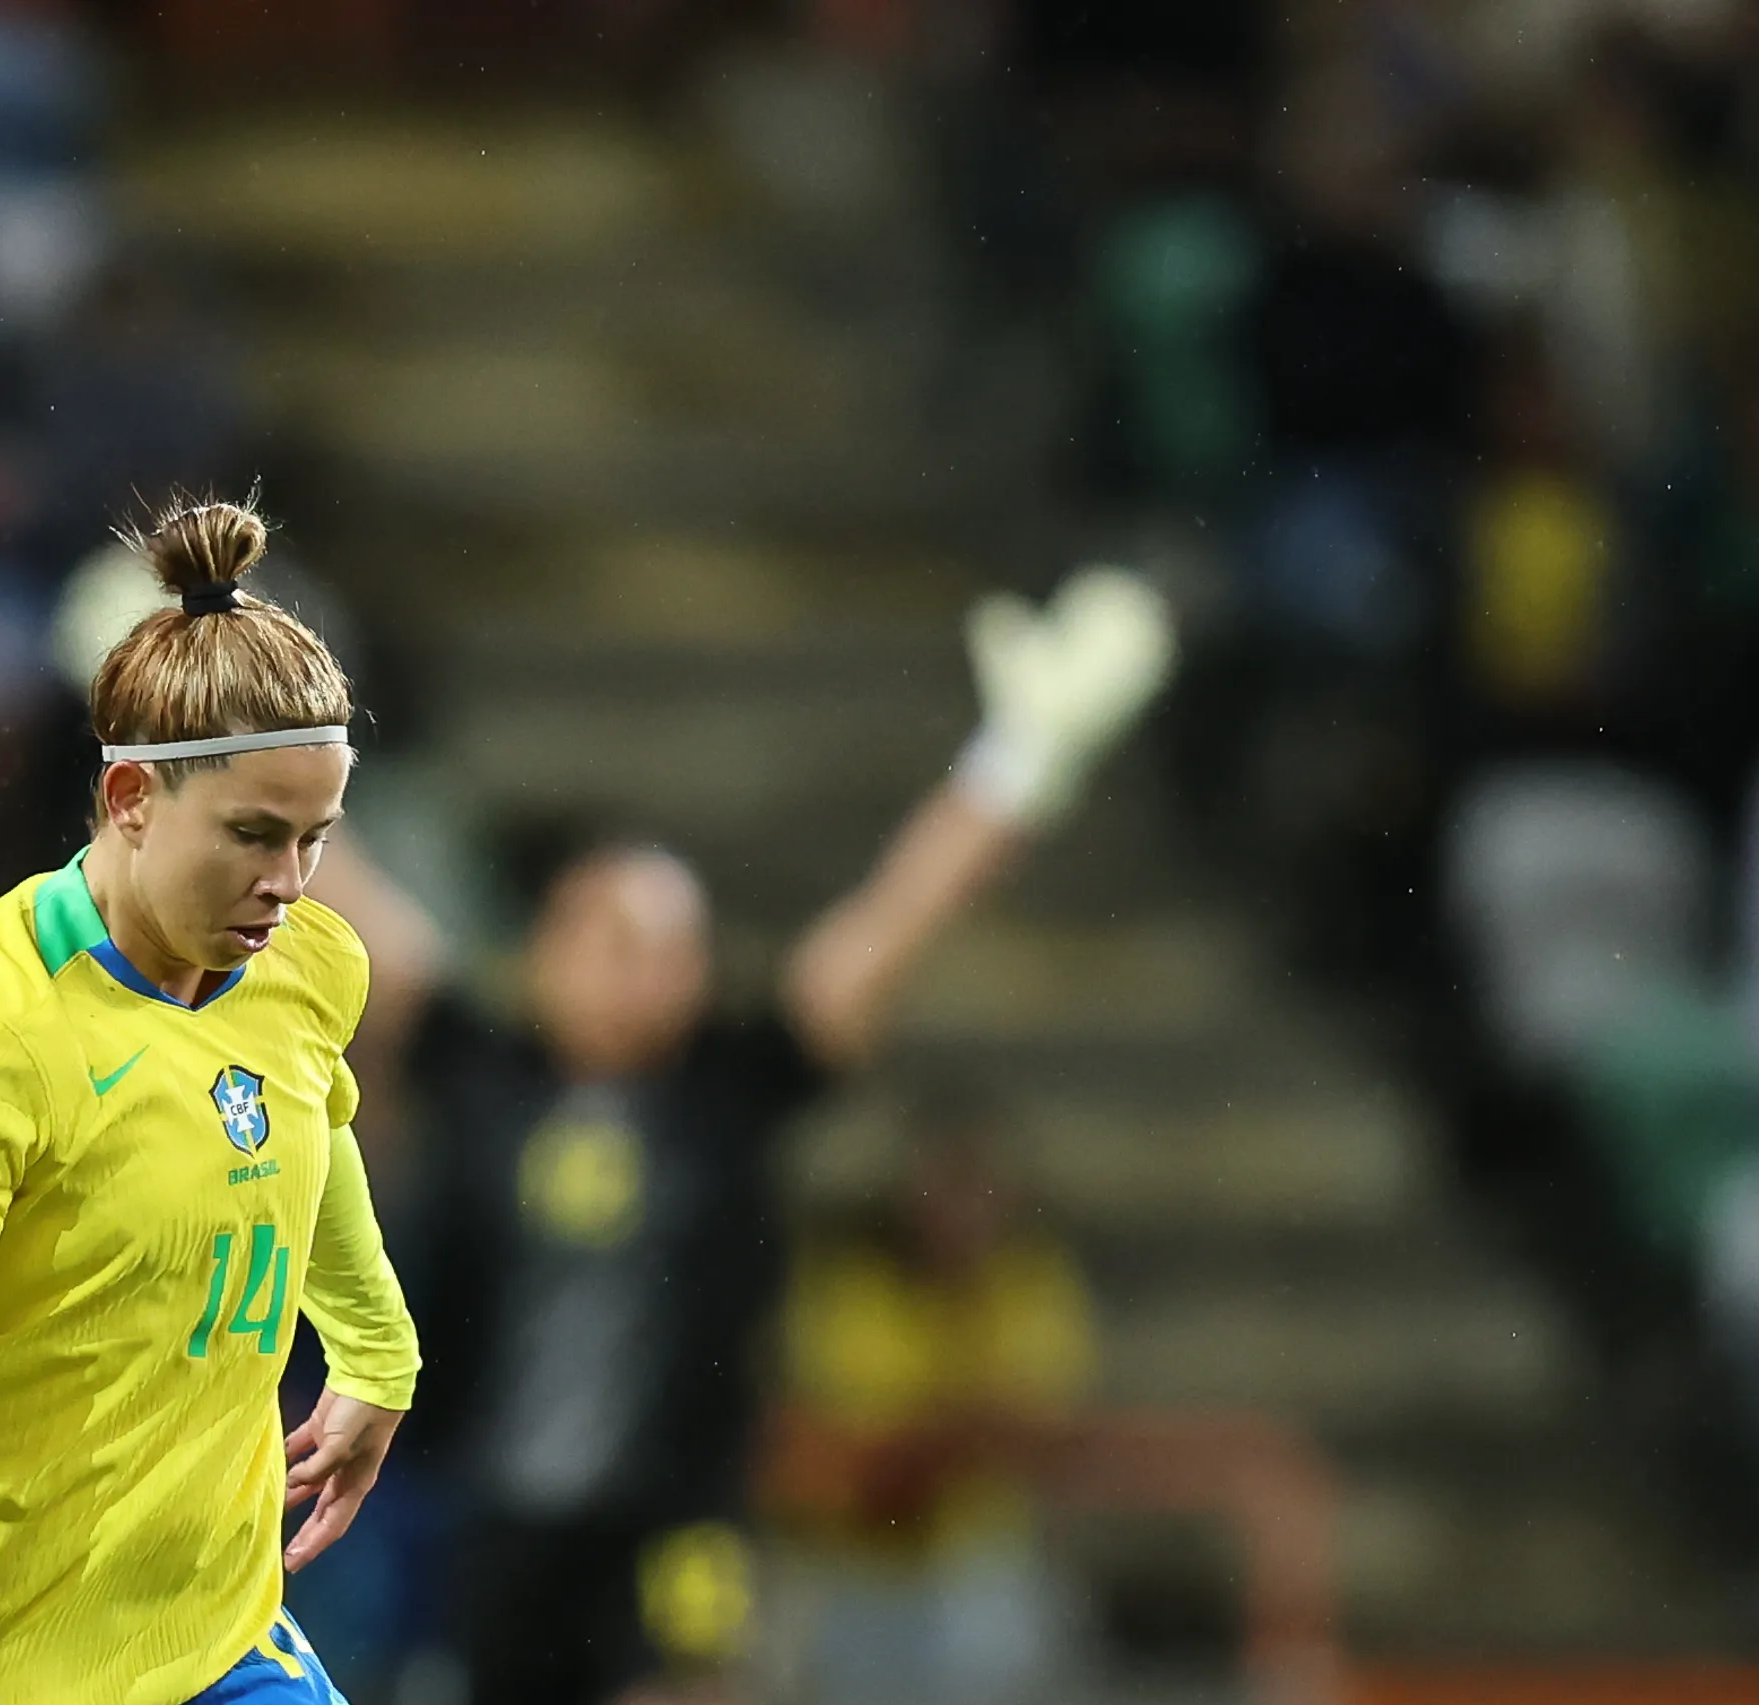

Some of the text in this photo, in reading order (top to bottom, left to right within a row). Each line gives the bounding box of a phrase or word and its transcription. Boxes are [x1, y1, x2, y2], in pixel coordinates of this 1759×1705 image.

[229, 1101, 250, 1117] CBF
[228, 1159, 281, 1186] BRASIL
[187, 1223, 290, 1359] 14
